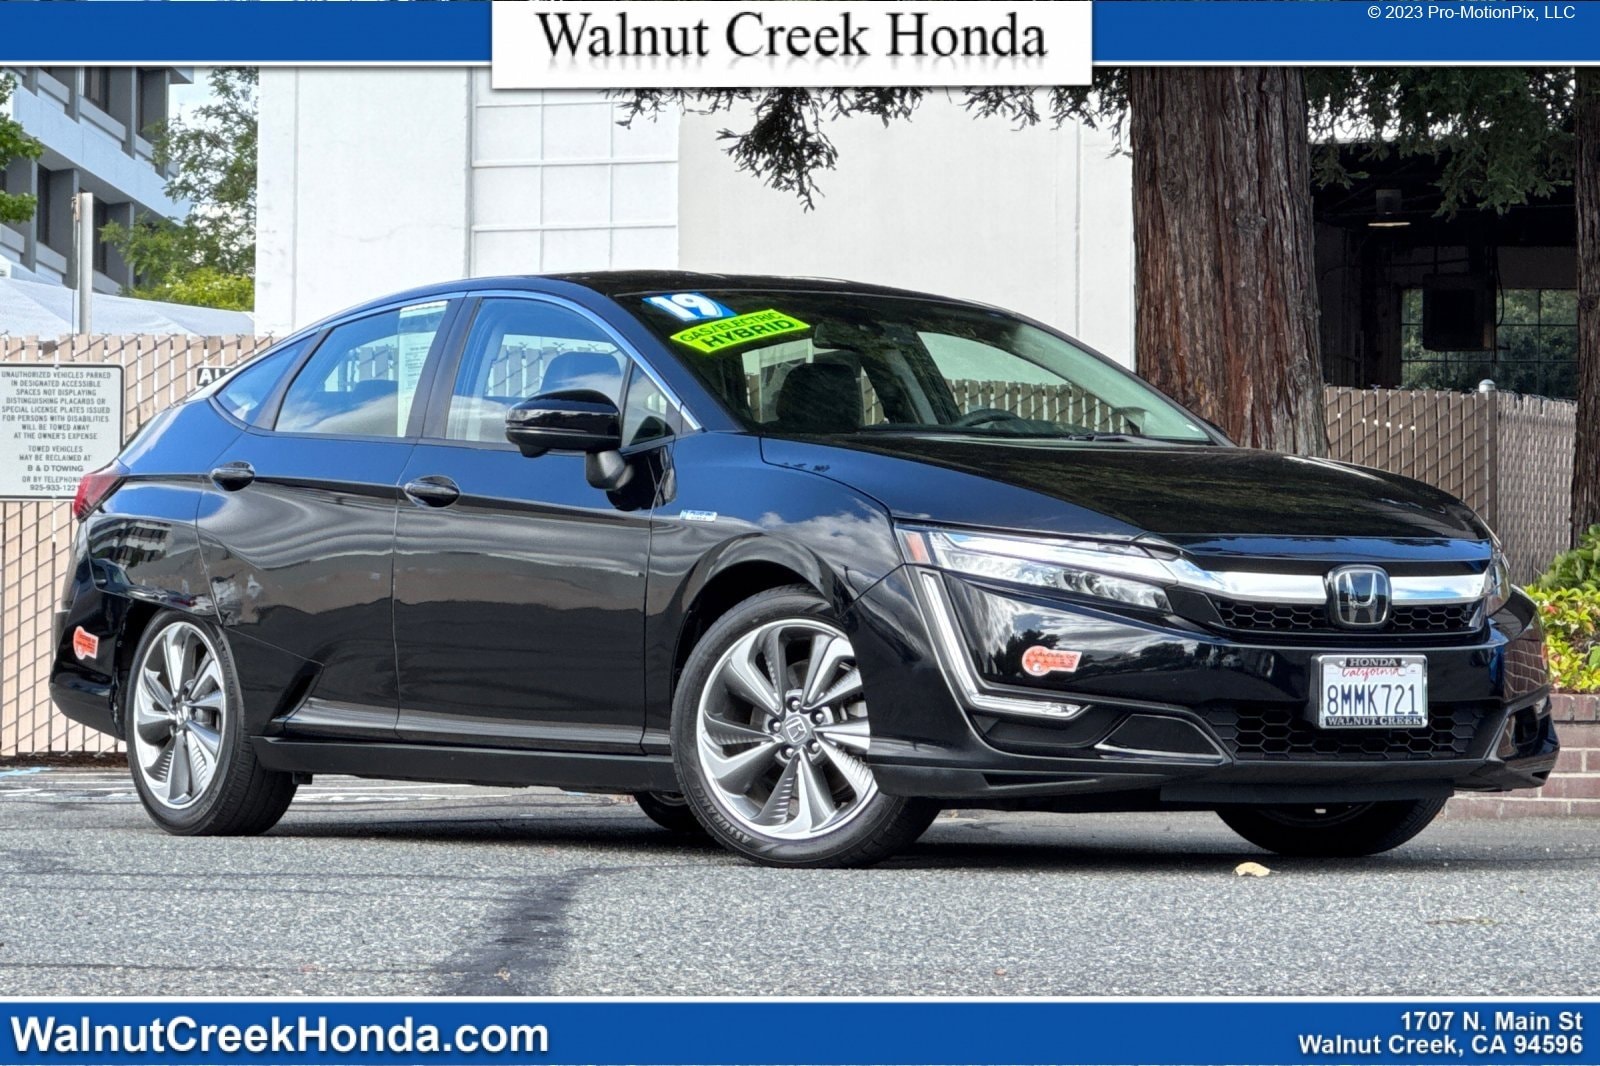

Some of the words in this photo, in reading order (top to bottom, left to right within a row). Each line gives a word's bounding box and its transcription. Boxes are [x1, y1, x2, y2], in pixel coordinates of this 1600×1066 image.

[649, 293, 724, 321] 19
[680, 312, 782, 342] GAS/ELECTRIC
[701, 320, 796, 348] HYBRID
[1342, 667, 1406, 682] California
[1350, 658, 1398, 666] HONDA
[1327, 684, 1418, 715] 8MMK721
[1328, 716, 1378, 726] WALNUT
[1380, 716, 1420, 725] CREEK
